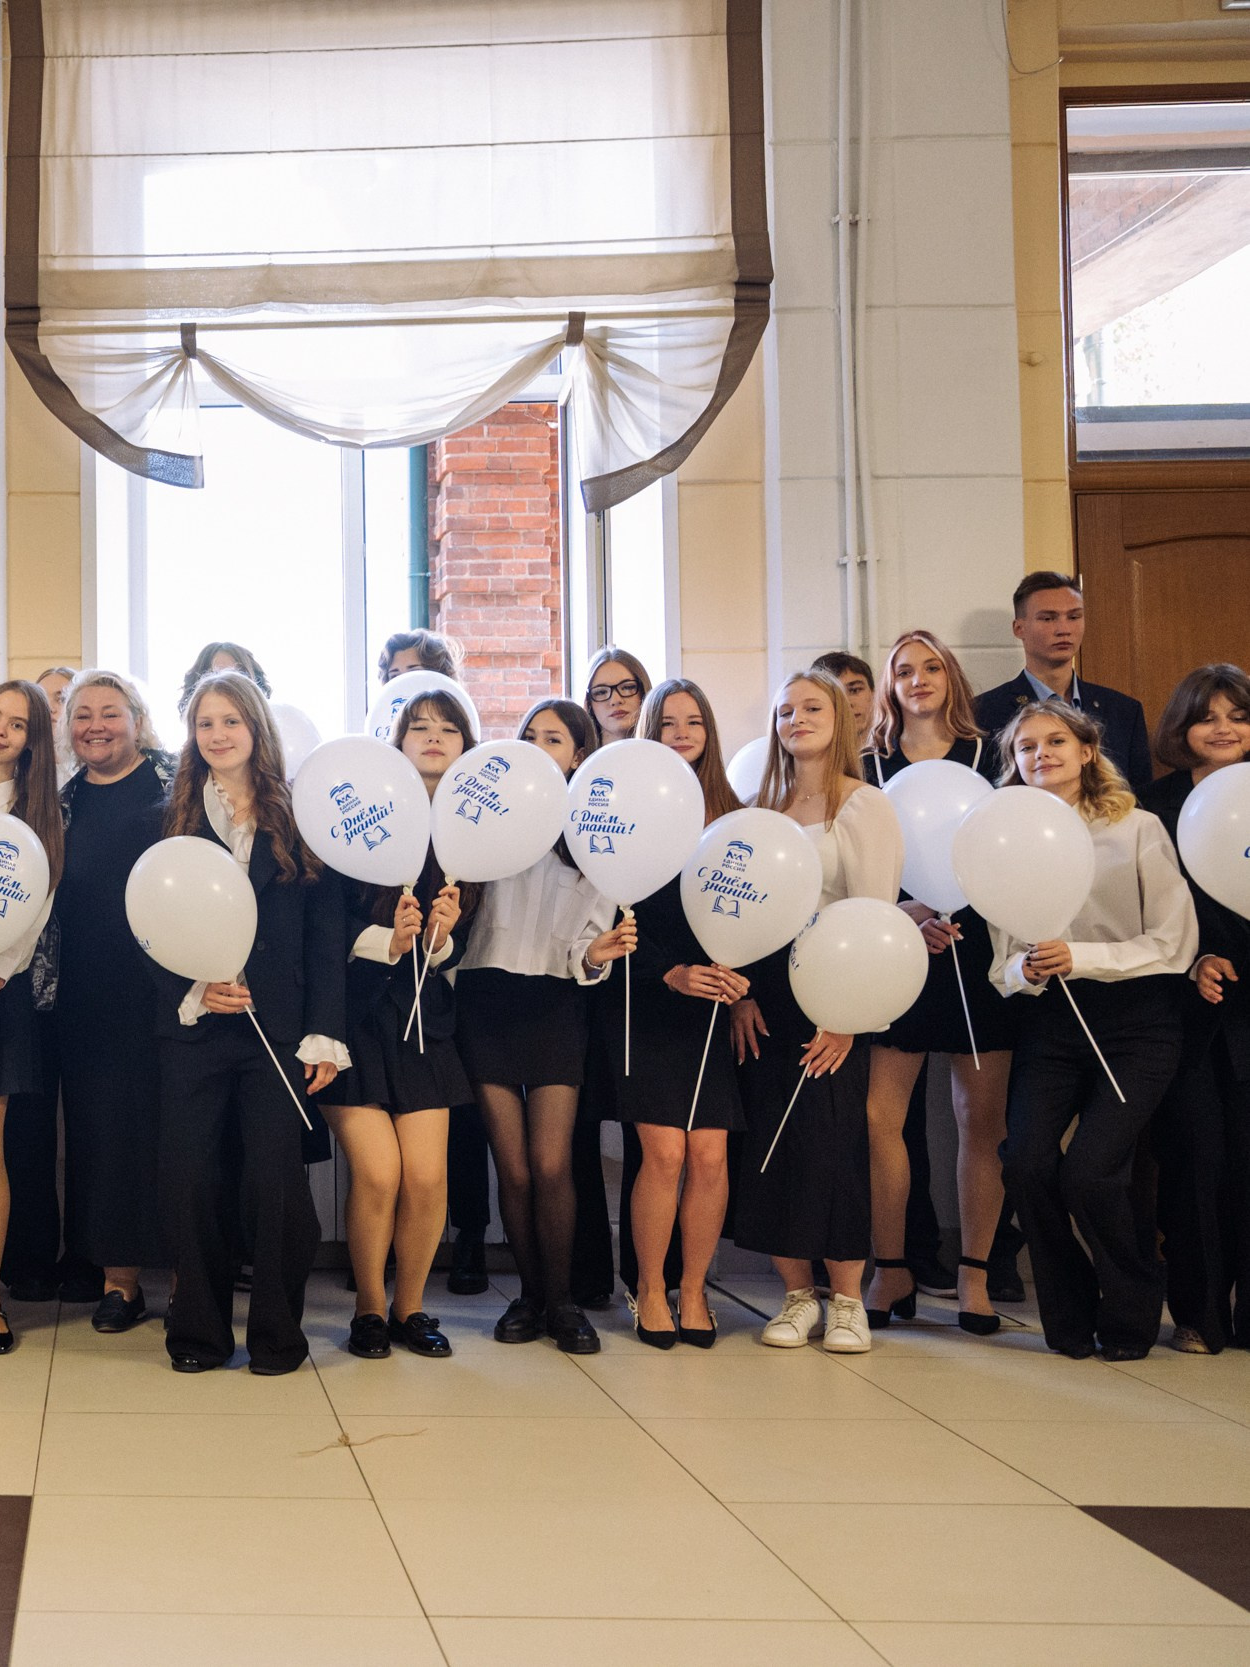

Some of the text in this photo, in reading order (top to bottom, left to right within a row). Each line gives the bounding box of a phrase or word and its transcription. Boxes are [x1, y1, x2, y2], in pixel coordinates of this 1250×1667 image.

[454, 772, 500, 801] С Днём
[452, 784, 510, 816] знаний!
[330, 804, 378, 839] С Днём
[343, 800, 394, 847] знаний!
[570, 809, 619, 825] С Днём
[575, 822, 636, 837] знаний!
[697, 866, 753, 891] С Днём
[721, 863, 746, 873] РОССИЯ
[700, 880, 768, 904] знаний!
